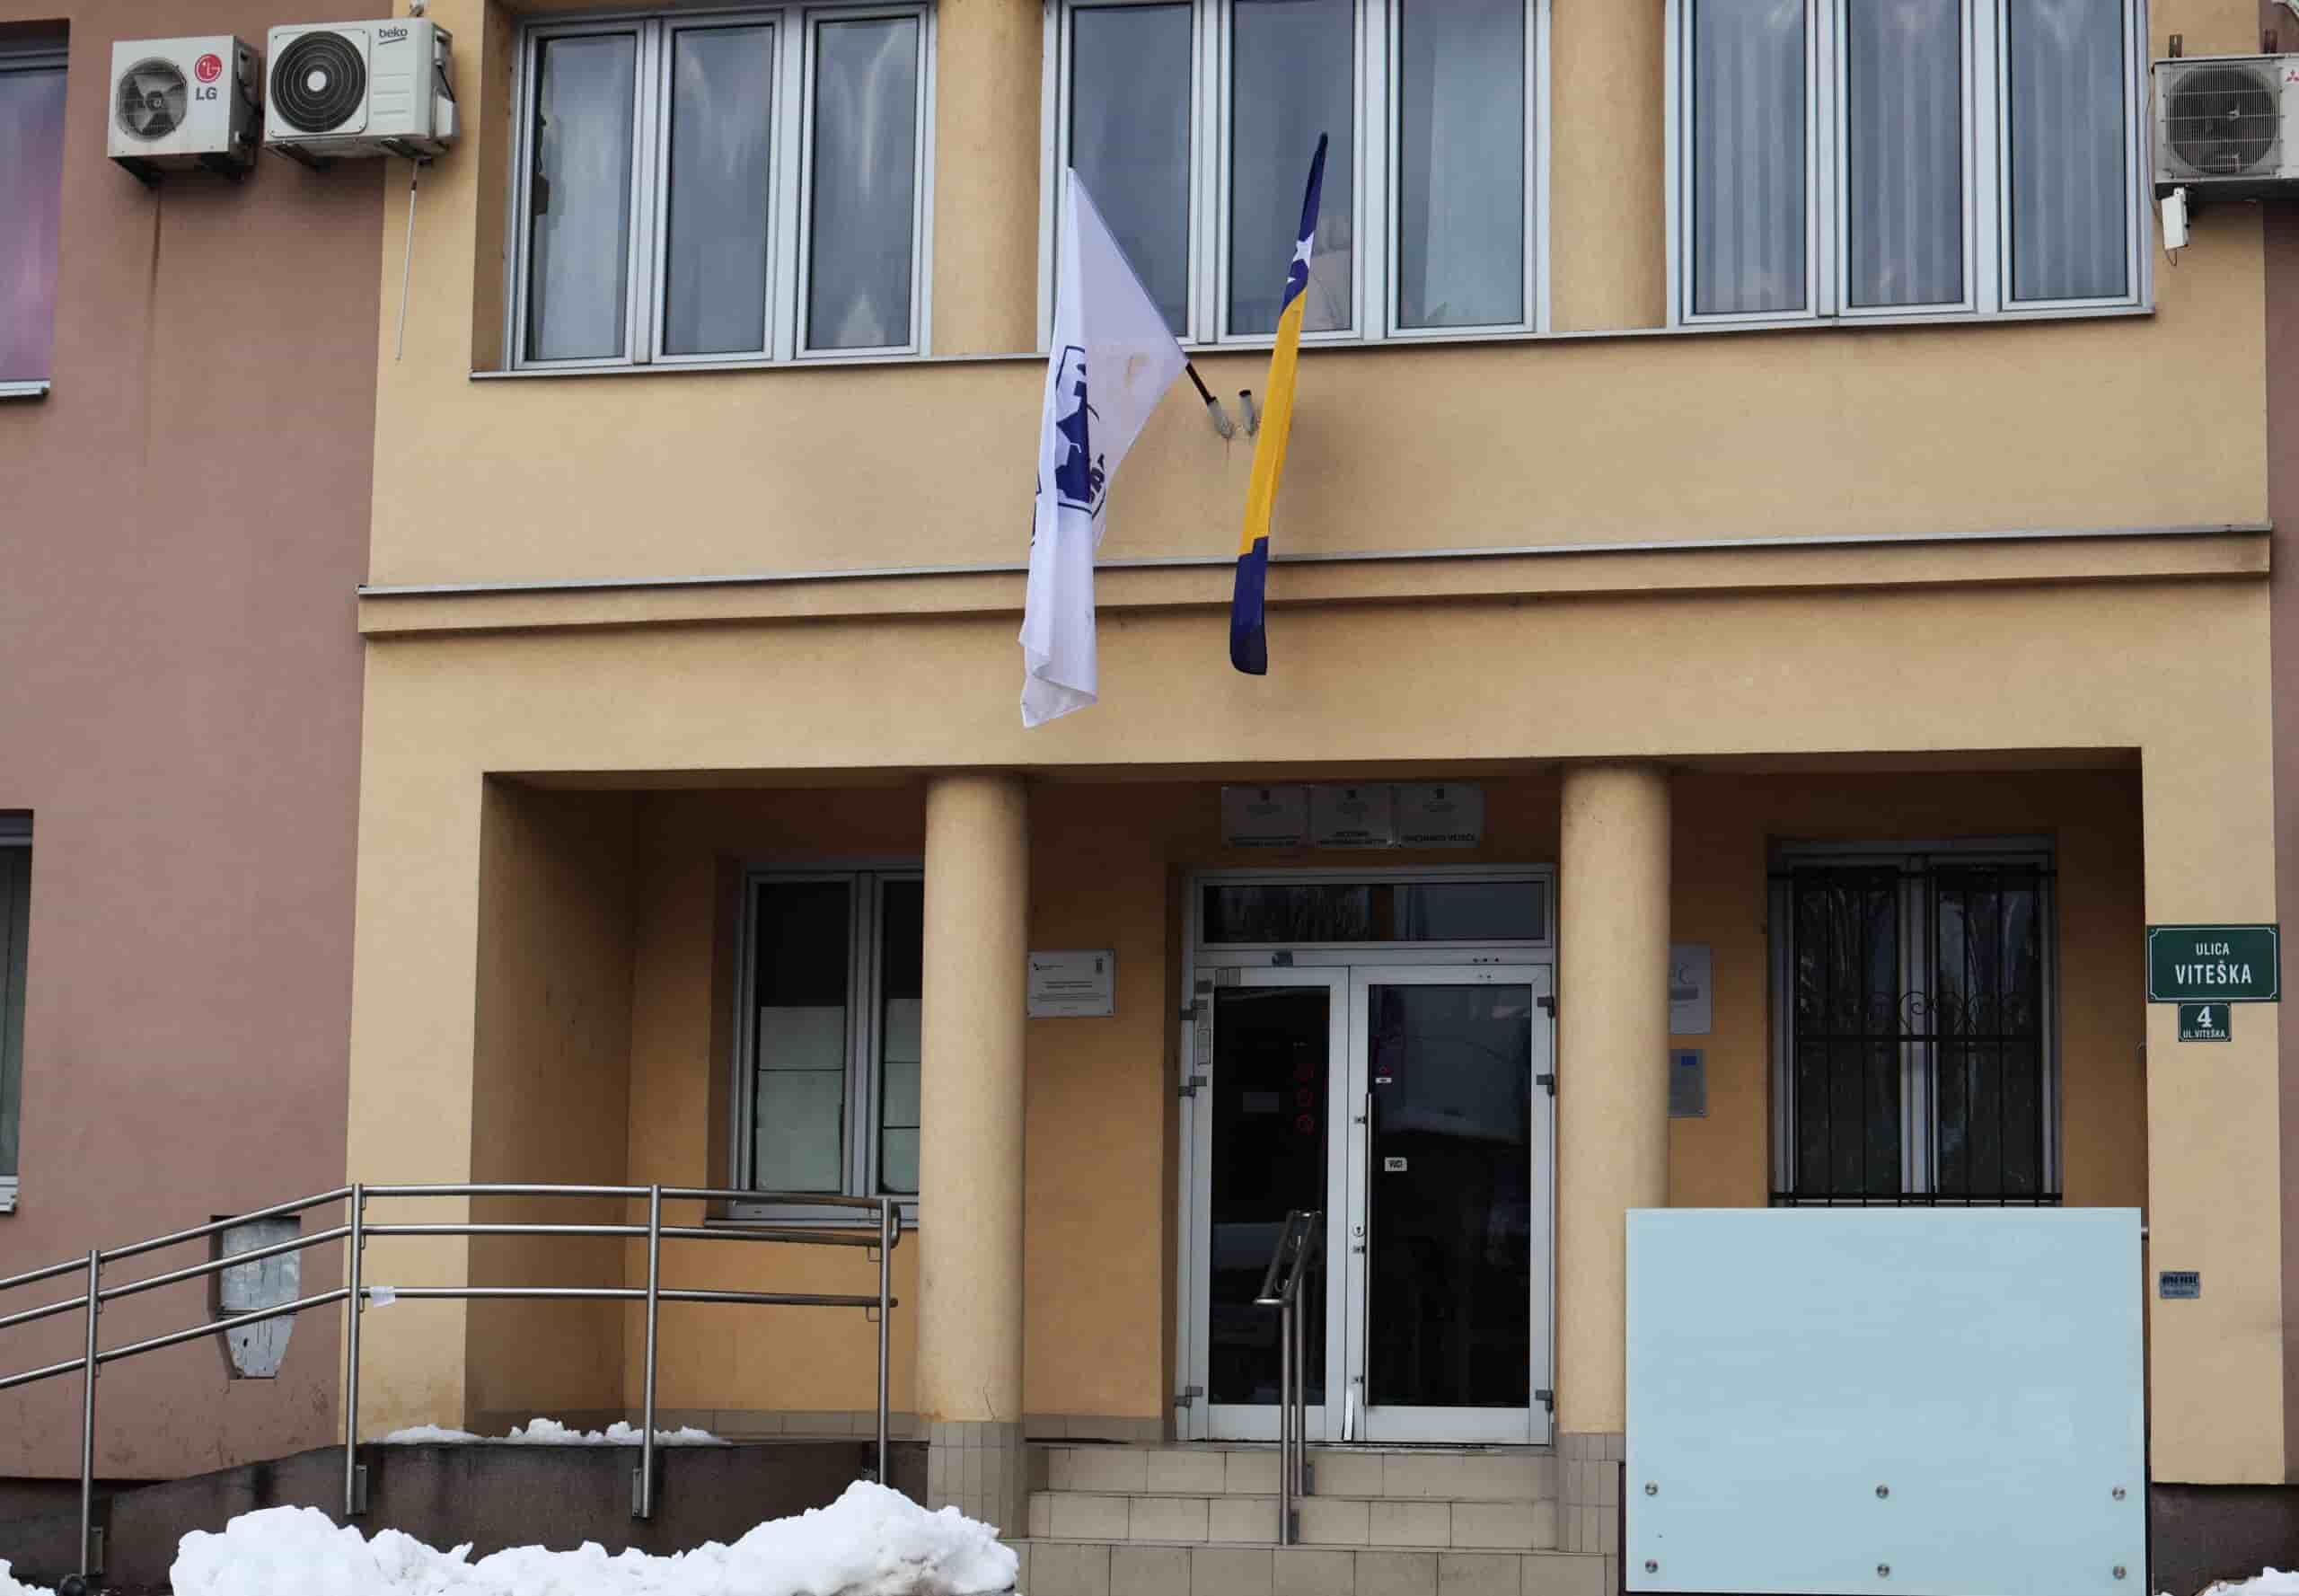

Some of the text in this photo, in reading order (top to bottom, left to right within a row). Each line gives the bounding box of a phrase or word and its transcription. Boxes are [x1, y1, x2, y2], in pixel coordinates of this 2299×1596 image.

[378, 27, 408, 39] beko
[195, 87, 217, 101] LG
[2196, 942, 2230, 957] ULICA
[2175, 960, 2252, 984] VITEŠKA
[2197, 1006, 2213, 1027] 4
